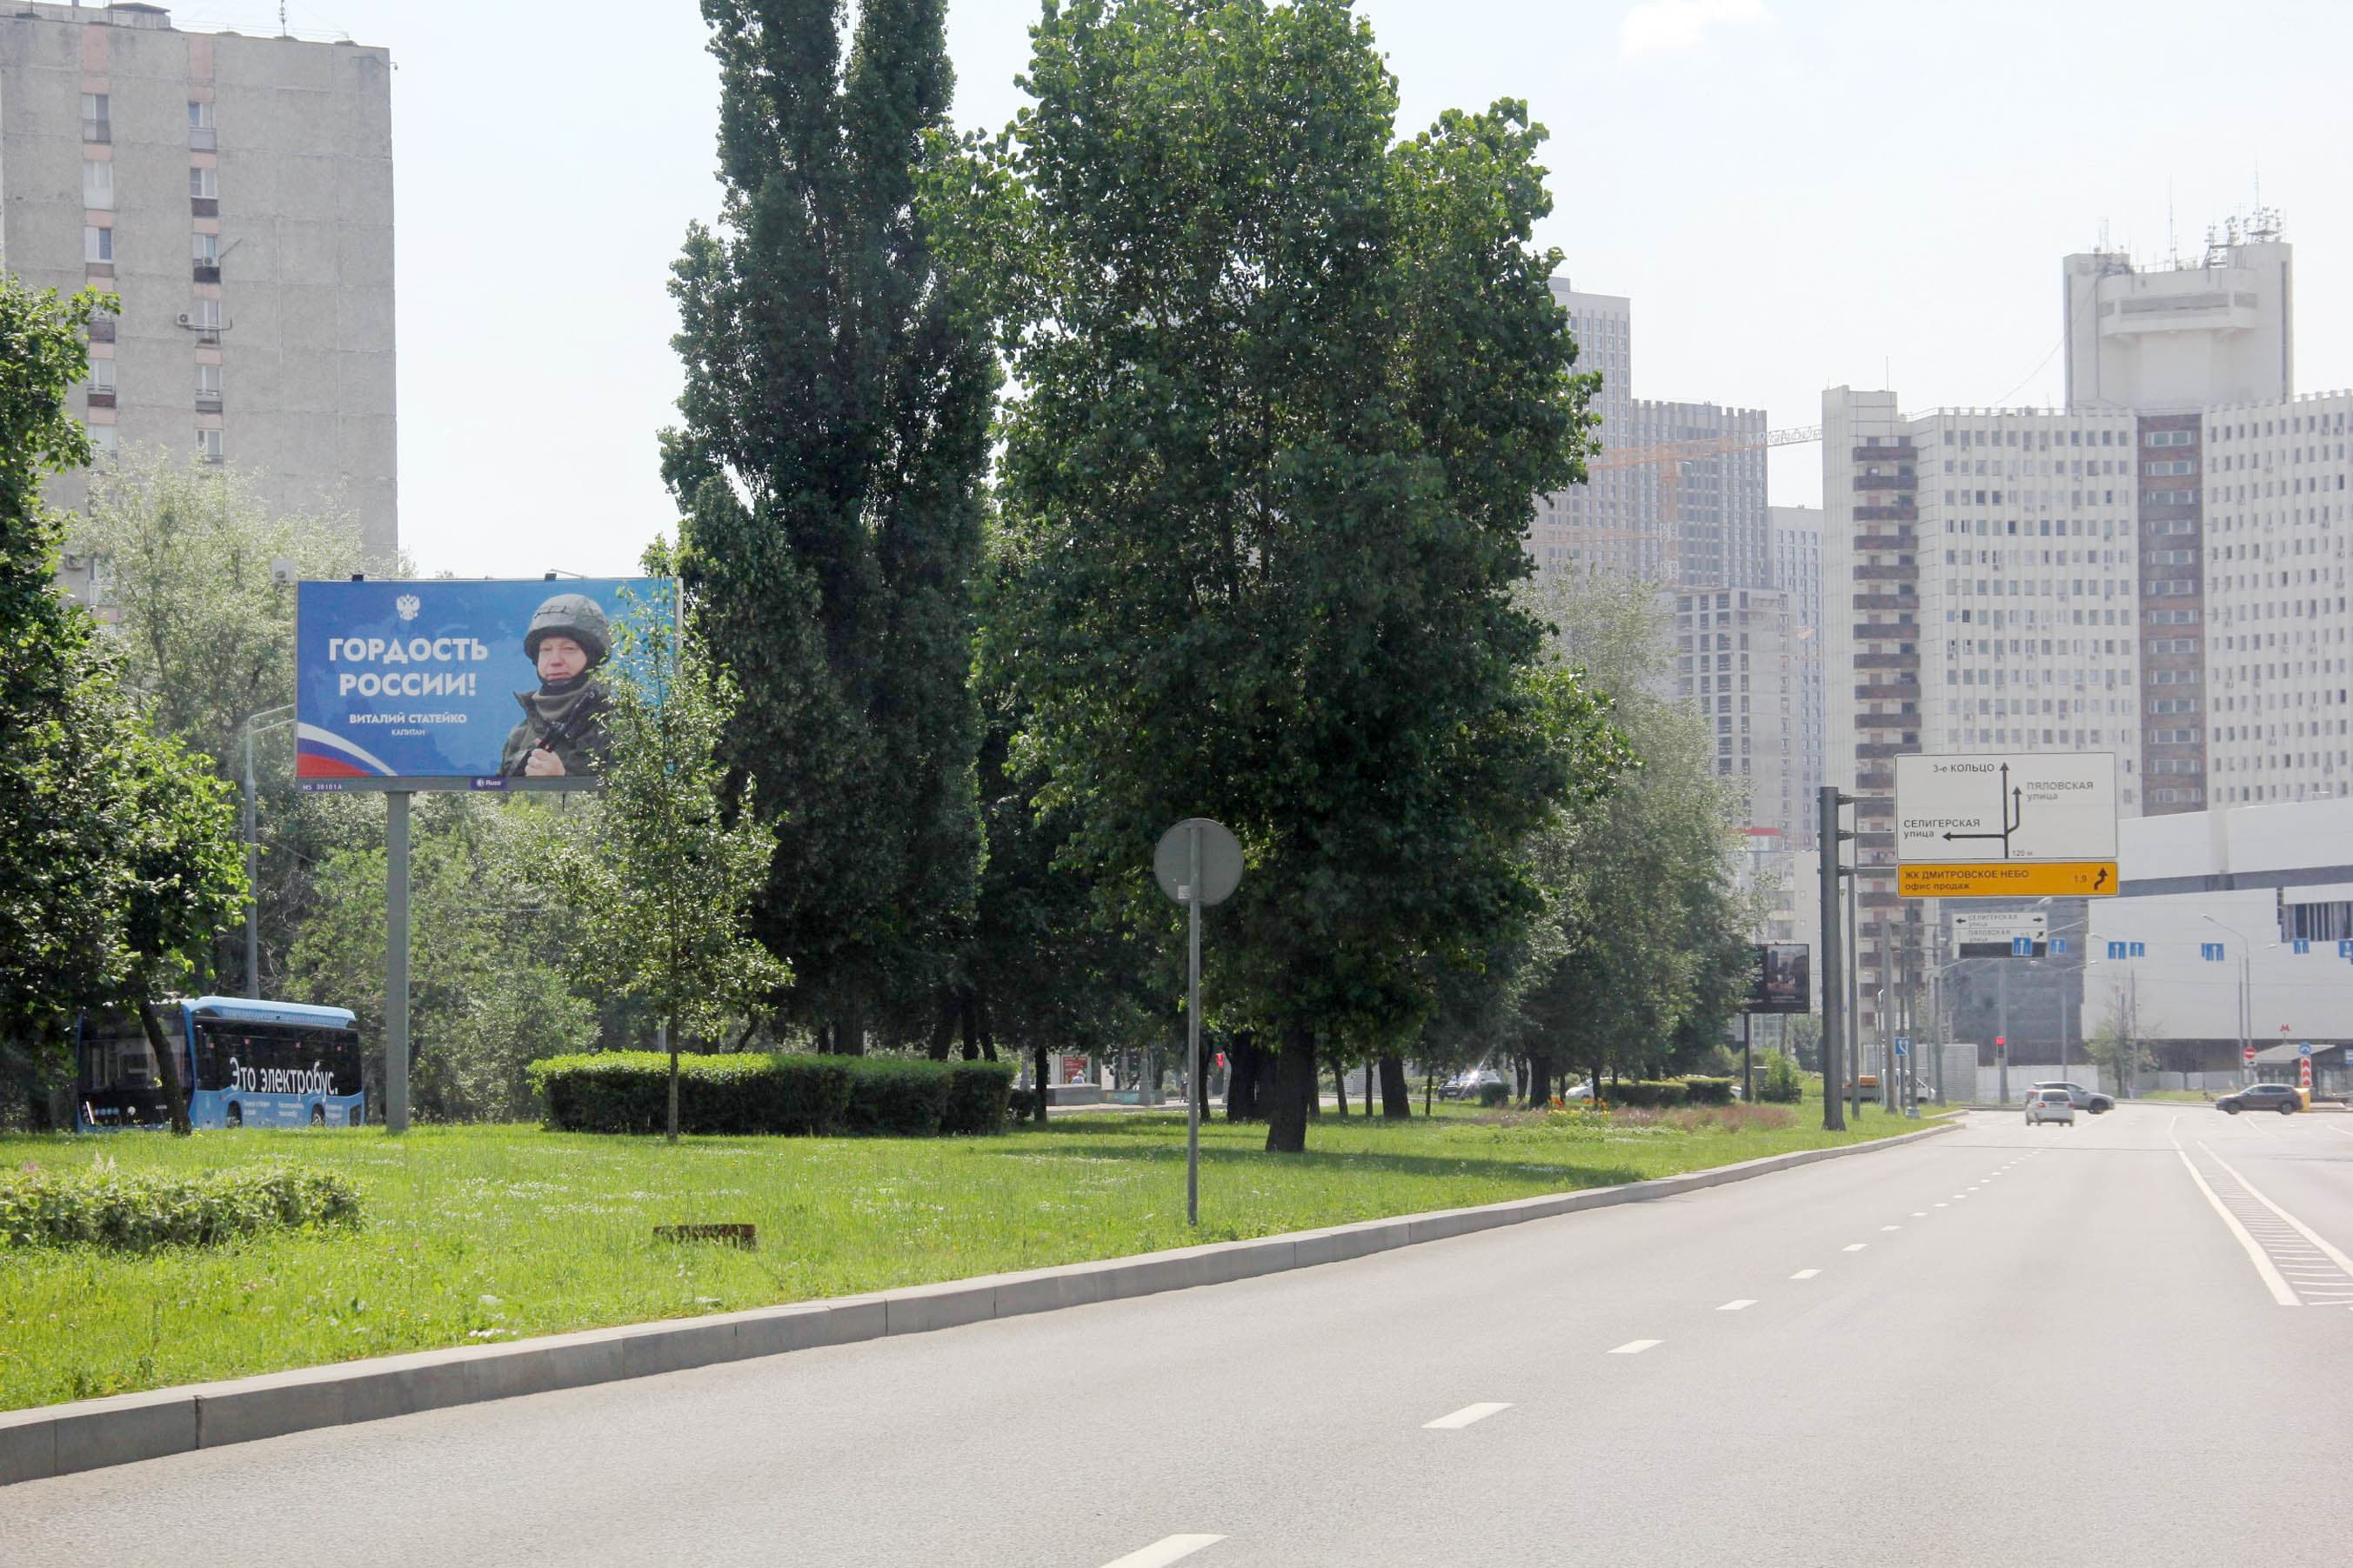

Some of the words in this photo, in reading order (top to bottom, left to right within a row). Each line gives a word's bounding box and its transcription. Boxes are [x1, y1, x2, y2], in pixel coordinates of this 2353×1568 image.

[329, 637, 488, 664] ГОРДОСТЬ
[339, 673, 476, 697] РОССИИ!
[349, 712, 405, 724] ВИТАЛИЙ
[409, 711, 467, 724] СТАТЕЙКО
[1950, 764, 1995, 772] КОЛЬЦО
[2027, 781, 2094, 790] ПЯЛОВСКАЯ
[1903, 818, 1981, 828] СЕЛИГЕРСКАЯ
[1903, 831, 1935, 839] улица
[1905, 871, 1920, 879] ЖК
[1922, 870, 1998, 879] ДМИТРОВСКОЕ
[2001, 870, 2029, 878] НЕБО
[1905, 882, 1930, 891] офис
[1934, 882, 1970, 891] продаж
[230, 1057, 257, 1092] Это
[261, 1060, 338, 1103] электробус.
